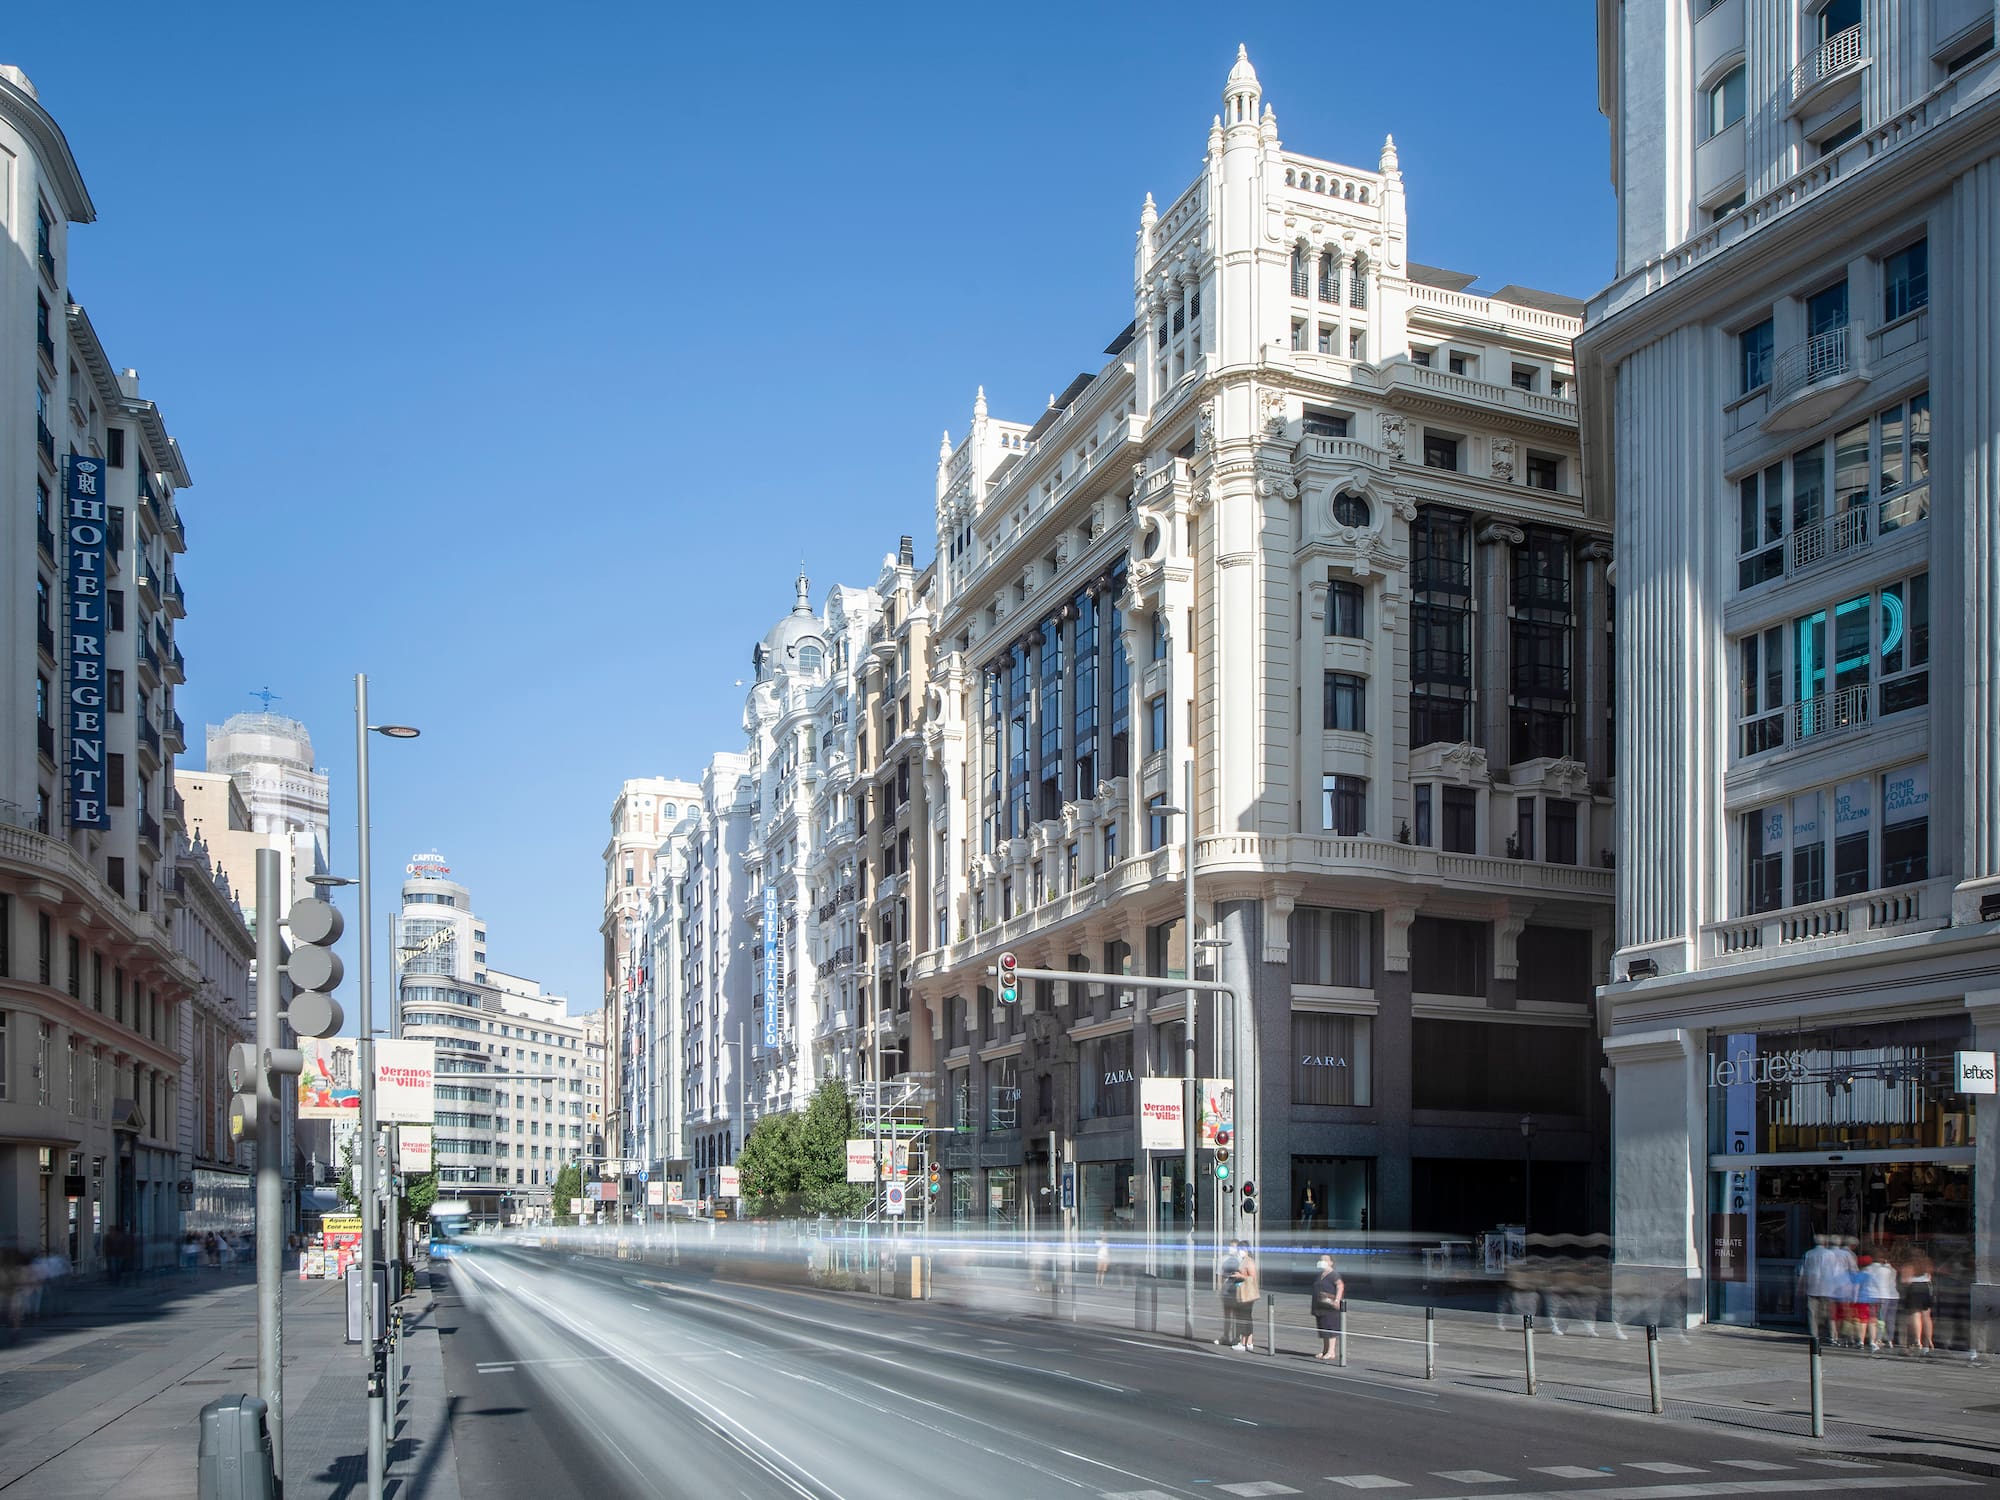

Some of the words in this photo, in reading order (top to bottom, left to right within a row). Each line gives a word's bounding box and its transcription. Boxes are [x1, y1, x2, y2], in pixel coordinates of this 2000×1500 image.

[70, 499, 104, 622] HOTEL
[71, 634, 103, 823] REGENTE
[1889, 778, 1914, 793] FIND
[766, 888, 775, 942] HOTEL
[766, 952, 775, 1045] ATLANTICO
[1302, 1055, 1347, 1067] ZARA
[380, 1065, 432, 1078] Veranos
[1708, 1049, 1809, 1088] lefties
[1962, 1064, 1994, 1080] lefties
[395, 1077, 425, 1088] Villa
[1104, 1069, 1134, 1085] ZARA
[1005, 1088, 1021, 1101] ZAR
[1143, 1103, 1181, 1112] Veranos
[1155, 1112, 1176, 1121] Villa
[1714, 1238, 1744, 1247] REMATE
[1714, 1249, 1736, 1258] FINAL
